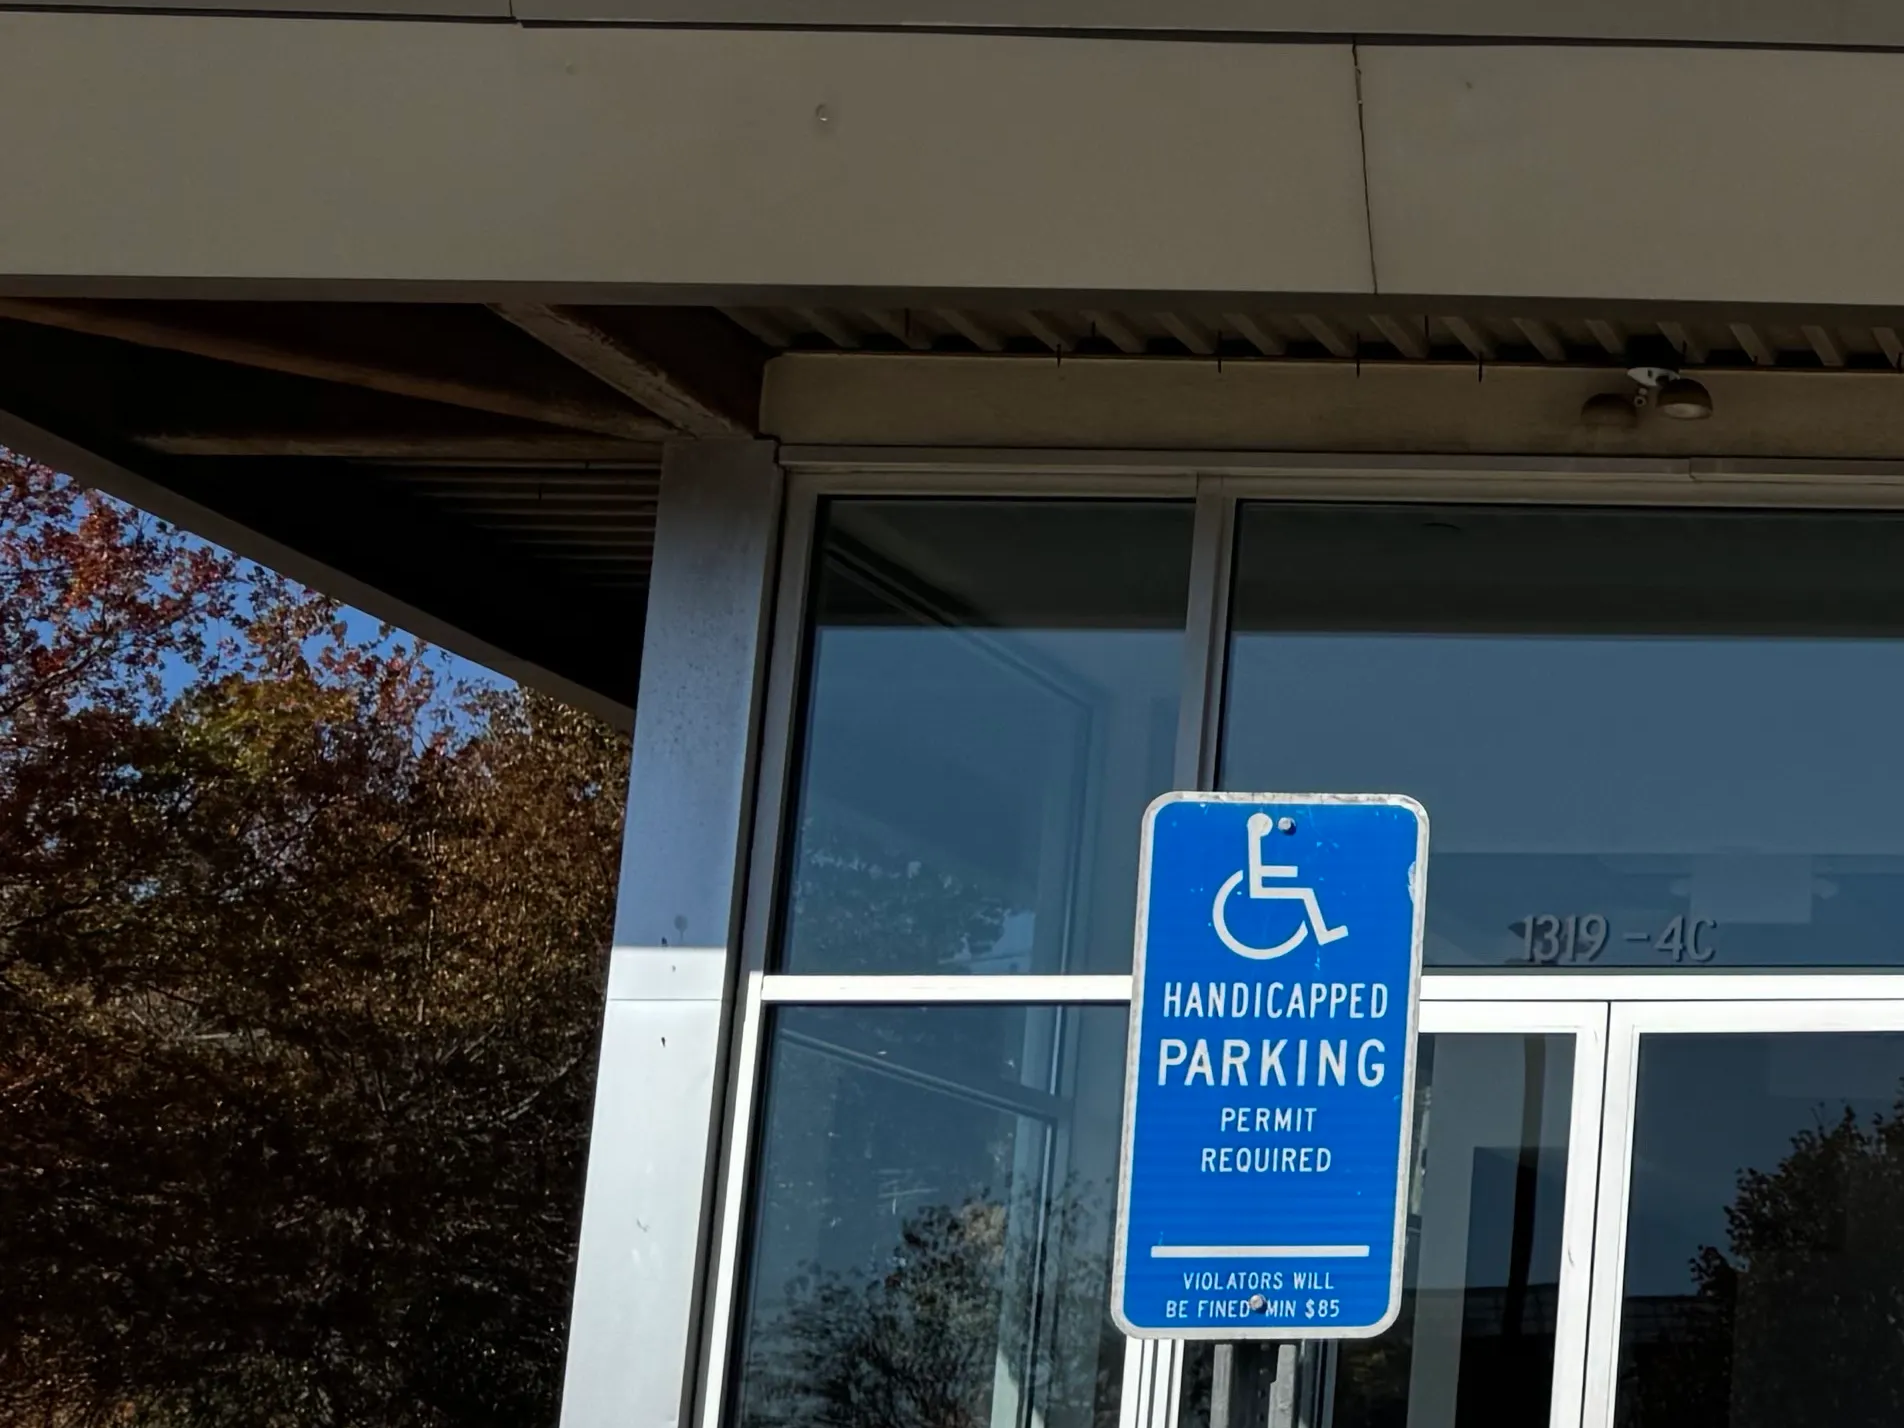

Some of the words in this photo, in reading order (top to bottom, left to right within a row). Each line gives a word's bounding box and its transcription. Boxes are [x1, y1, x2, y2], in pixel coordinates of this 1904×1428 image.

[1162, 981, 1388, 1020] HANDICAPPED
[1157, 1038, 1386, 1087] PARKING
[1220, 1106, 1317, 1132] PERMIT
[1201, 1147, 1332, 1173] REQUIRED
[1183, 1271, 1283, 1290] VIOLATORS
[1293, 1271, 1334, 1290] WILL
[1166, 1299, 1189, 1318] BE
[1197, 1299, 1251, 1318] FINED
[1265, 1299, 1297, 1318] MIN
[1304, 1298, 1340, 1318] $85
